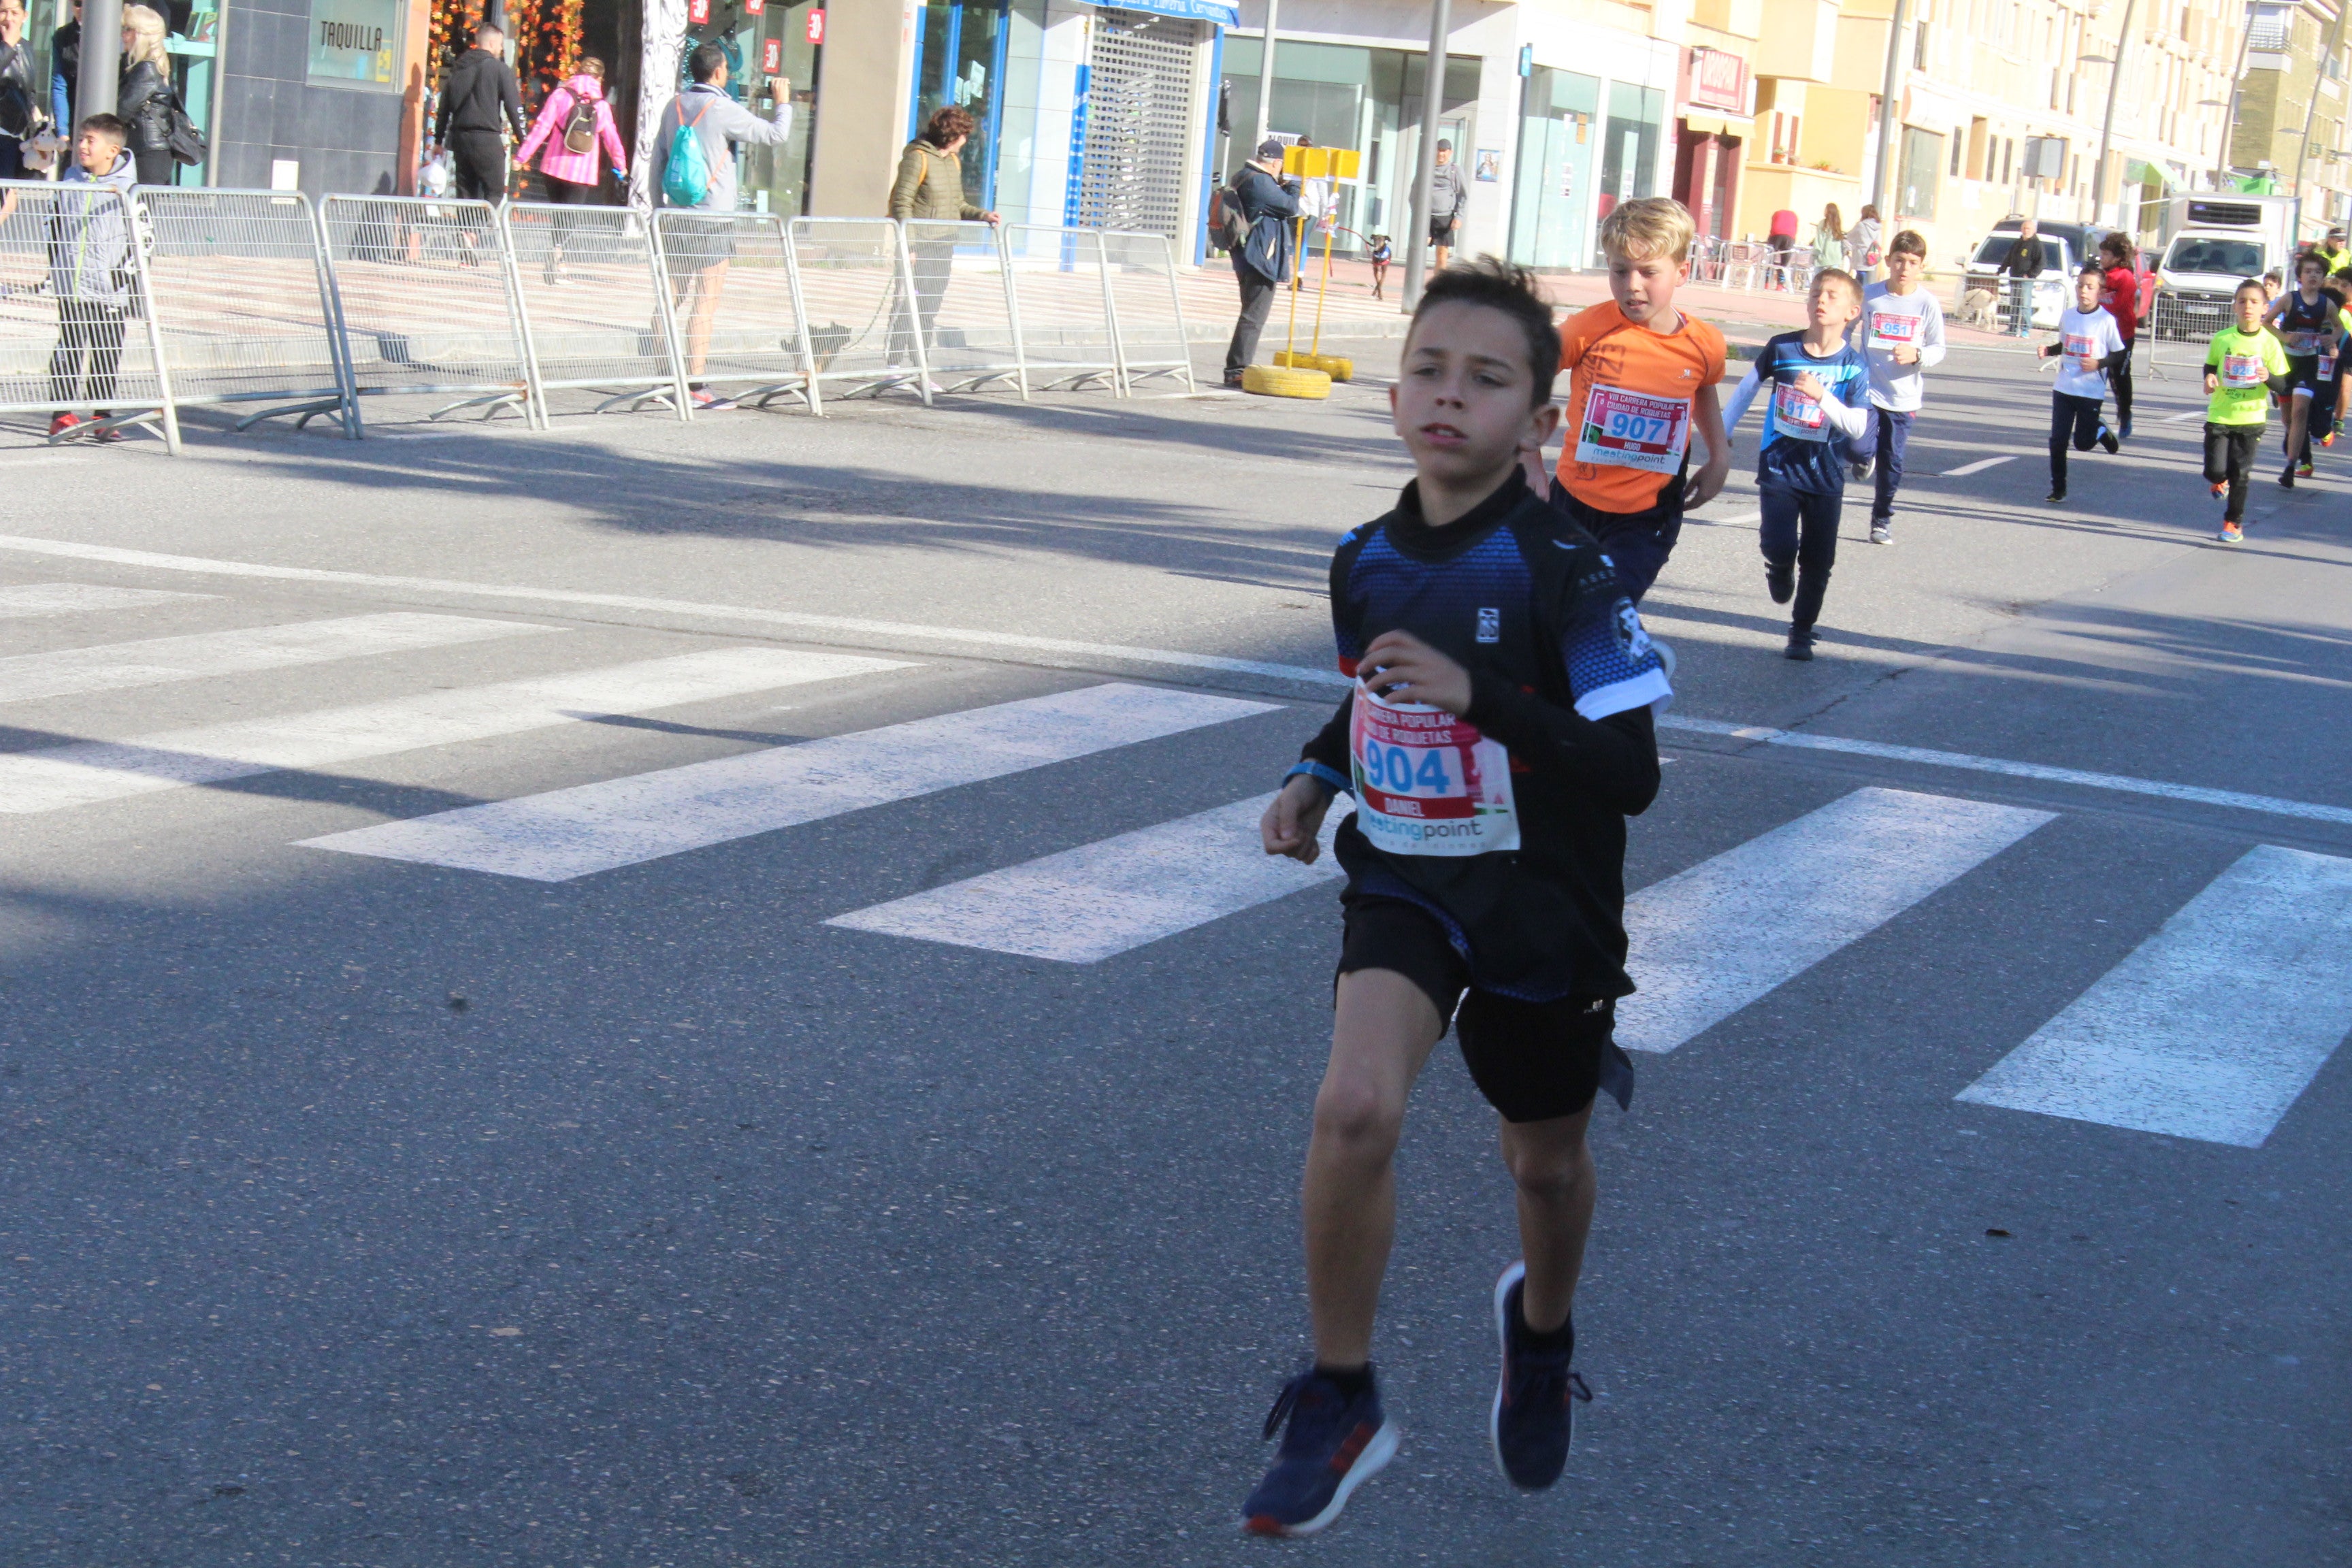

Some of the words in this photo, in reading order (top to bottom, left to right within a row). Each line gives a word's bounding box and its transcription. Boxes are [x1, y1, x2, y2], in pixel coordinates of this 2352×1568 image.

[321, 20, 382, 51] TAQUILLA
[1884, 323, 1908, 336] 951
[1606, 401, 1631, 412] CIUDAD
[1640, 407, 1671, 419] ROQUETAS
[1610, 393, 1618, 401] VIII
[1620, 395, 1648, 408] CARRERA
[1649, 400, 1676, 410] POPULAR
[1786, 400, 1818, 420] 917
[1611, 413, 1665, 442] 907
[1623, 442, 1642, 452] HUGO
[1400, 714, 1456, 728] POPULAR
[1392, 730, 1452, 744] ROQUETAS
[1367, 740, 1451, 794] 904
[1384, 797, 1426, 817] DANIEL
